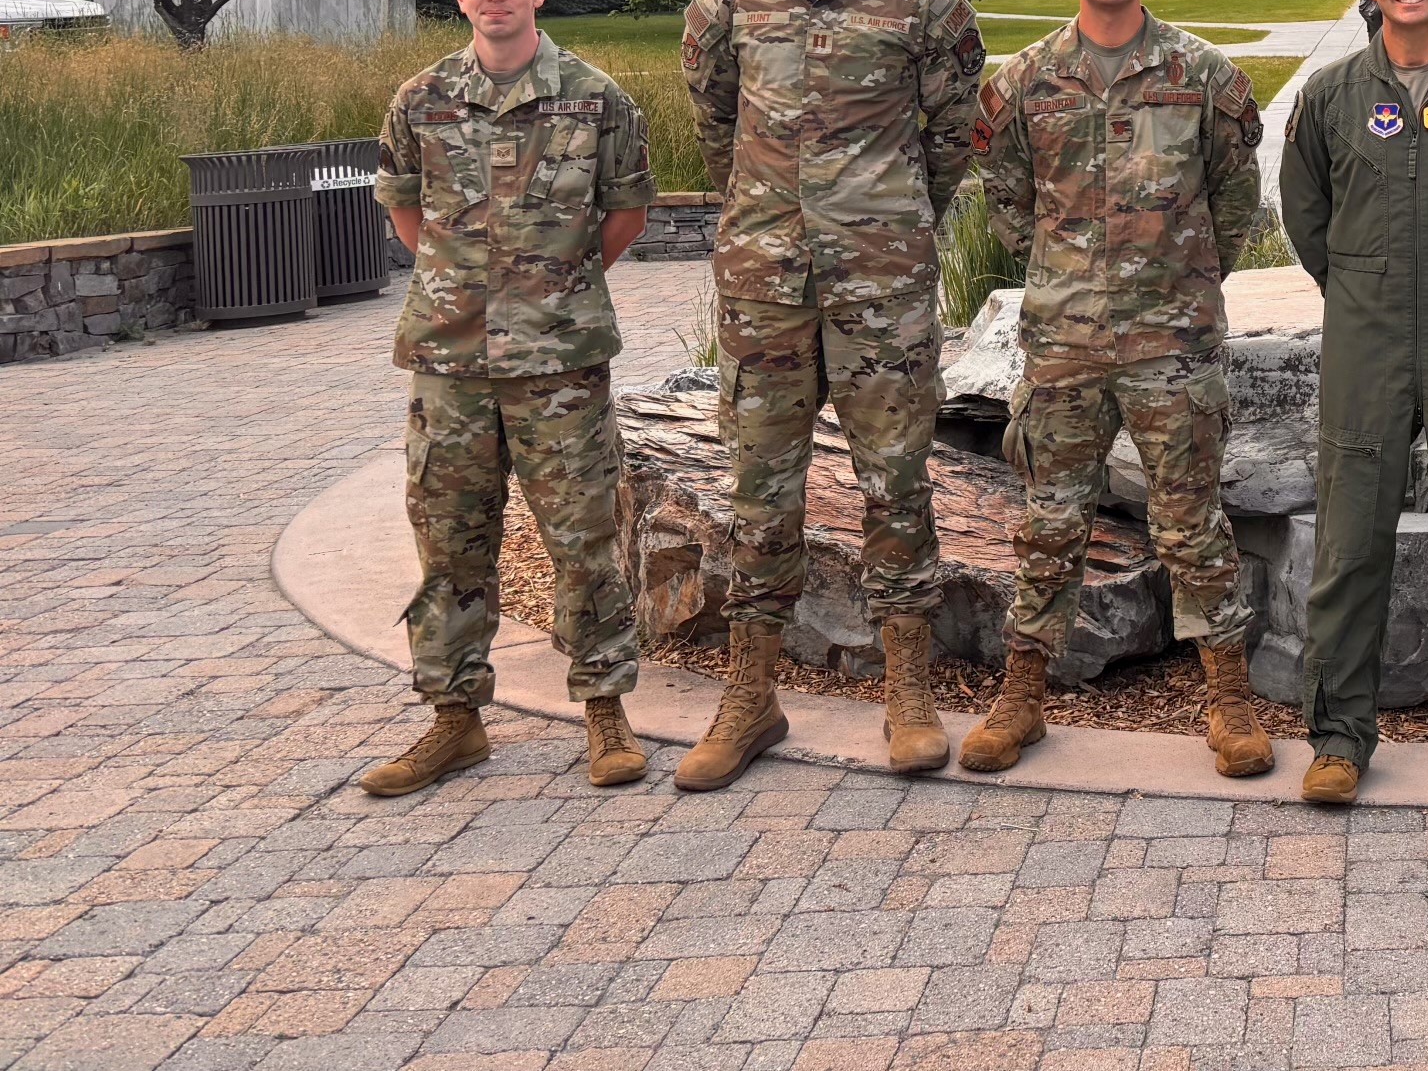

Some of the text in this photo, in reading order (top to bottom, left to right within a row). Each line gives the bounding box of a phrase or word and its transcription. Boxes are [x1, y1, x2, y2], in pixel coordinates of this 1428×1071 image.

[746, 13, 771, 23] HUNT
[850, 15, 907, 32] U.S. AIR FORCE
[946, 0, 971, 34] CADRE
[1230, 71, 1251, 101] CADRE
[1176, 92, 1202, 103] FORCE
[558, 101, 572, 112] AIR
[573, 100, 599, 112] FORCE
[1034, 97, 1077, 112] BURNHAM
[332, 177, 362, 187] Recycle
